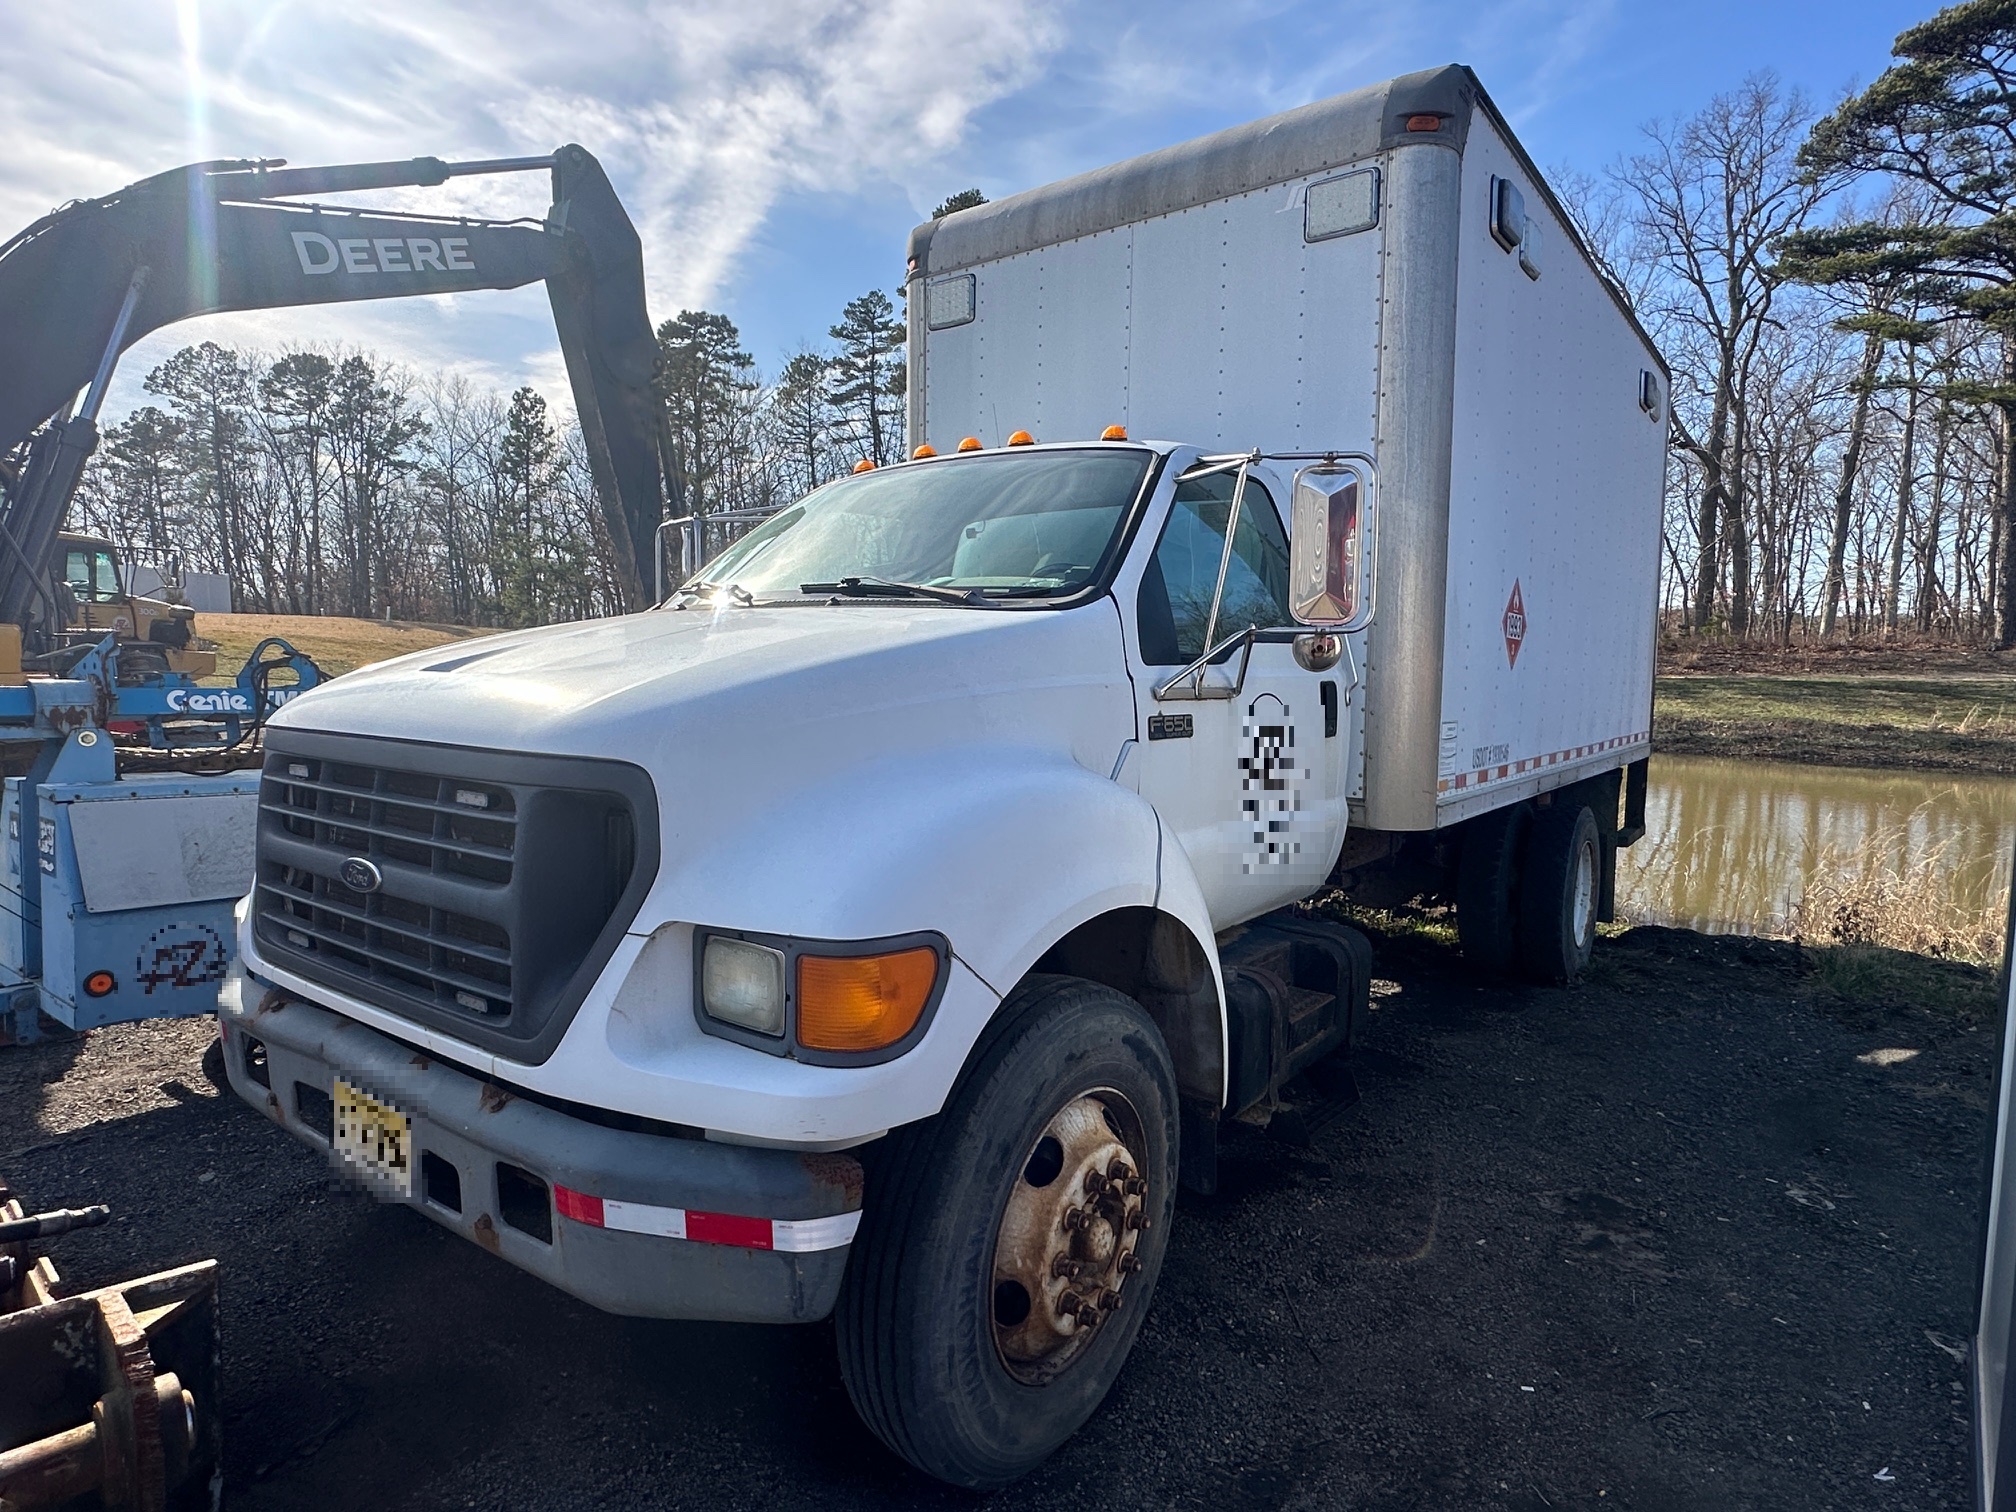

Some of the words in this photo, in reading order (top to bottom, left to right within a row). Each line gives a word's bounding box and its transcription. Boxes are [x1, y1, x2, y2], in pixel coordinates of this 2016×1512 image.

[290, 231, 476, 275] DEERE
[1507, 613, 1522, 639] 1993
[166, 689, 248, 711] Genie
[347, 863, 370, 887] Ford
